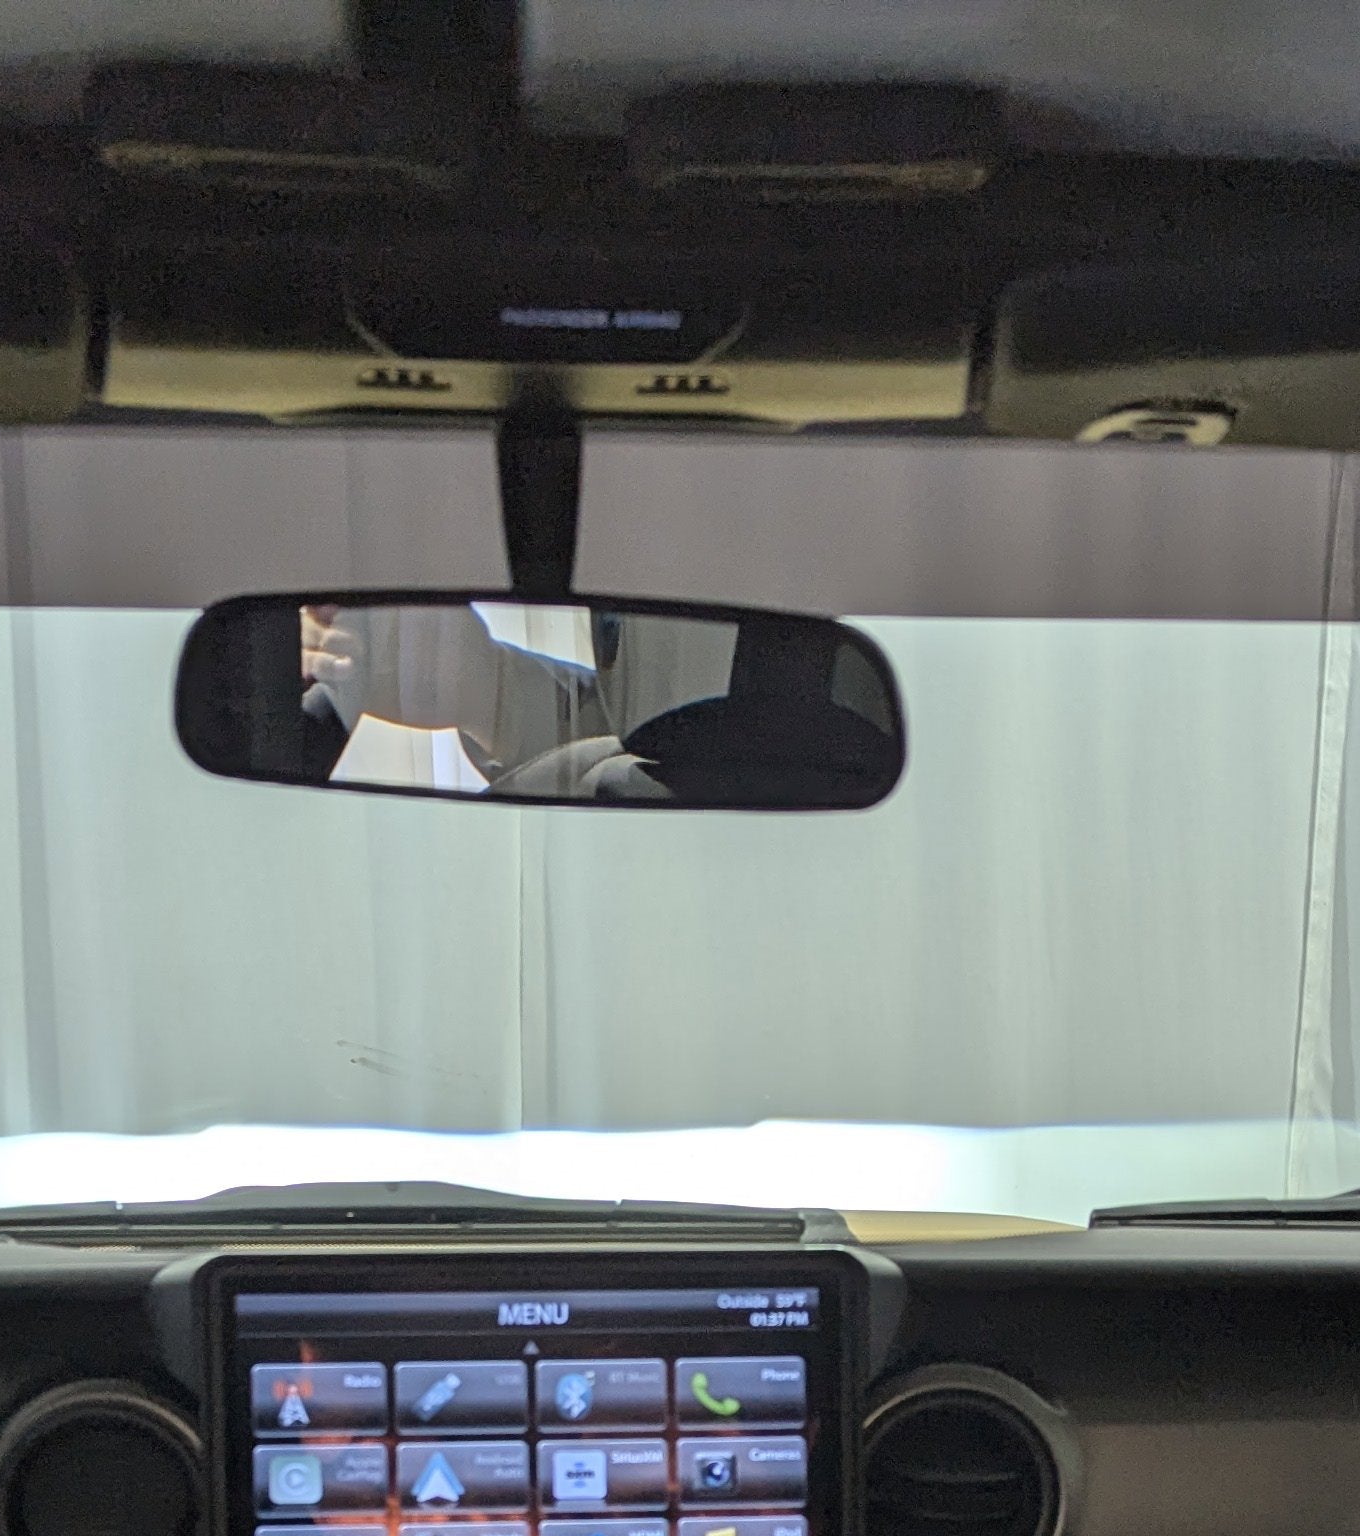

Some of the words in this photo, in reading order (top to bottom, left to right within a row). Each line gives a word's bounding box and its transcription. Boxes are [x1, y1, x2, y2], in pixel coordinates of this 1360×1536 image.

[497, 1303, 570, 1326] MENU
[785, 1311, 809, 1327] PM
[343, 1373, 382, 1388] Radio
[761, 1367, 801, 1382] Phone
[609, 1450, 664, 1464] SiriusXM
[748, 1448, 802, 1462] Cameras
